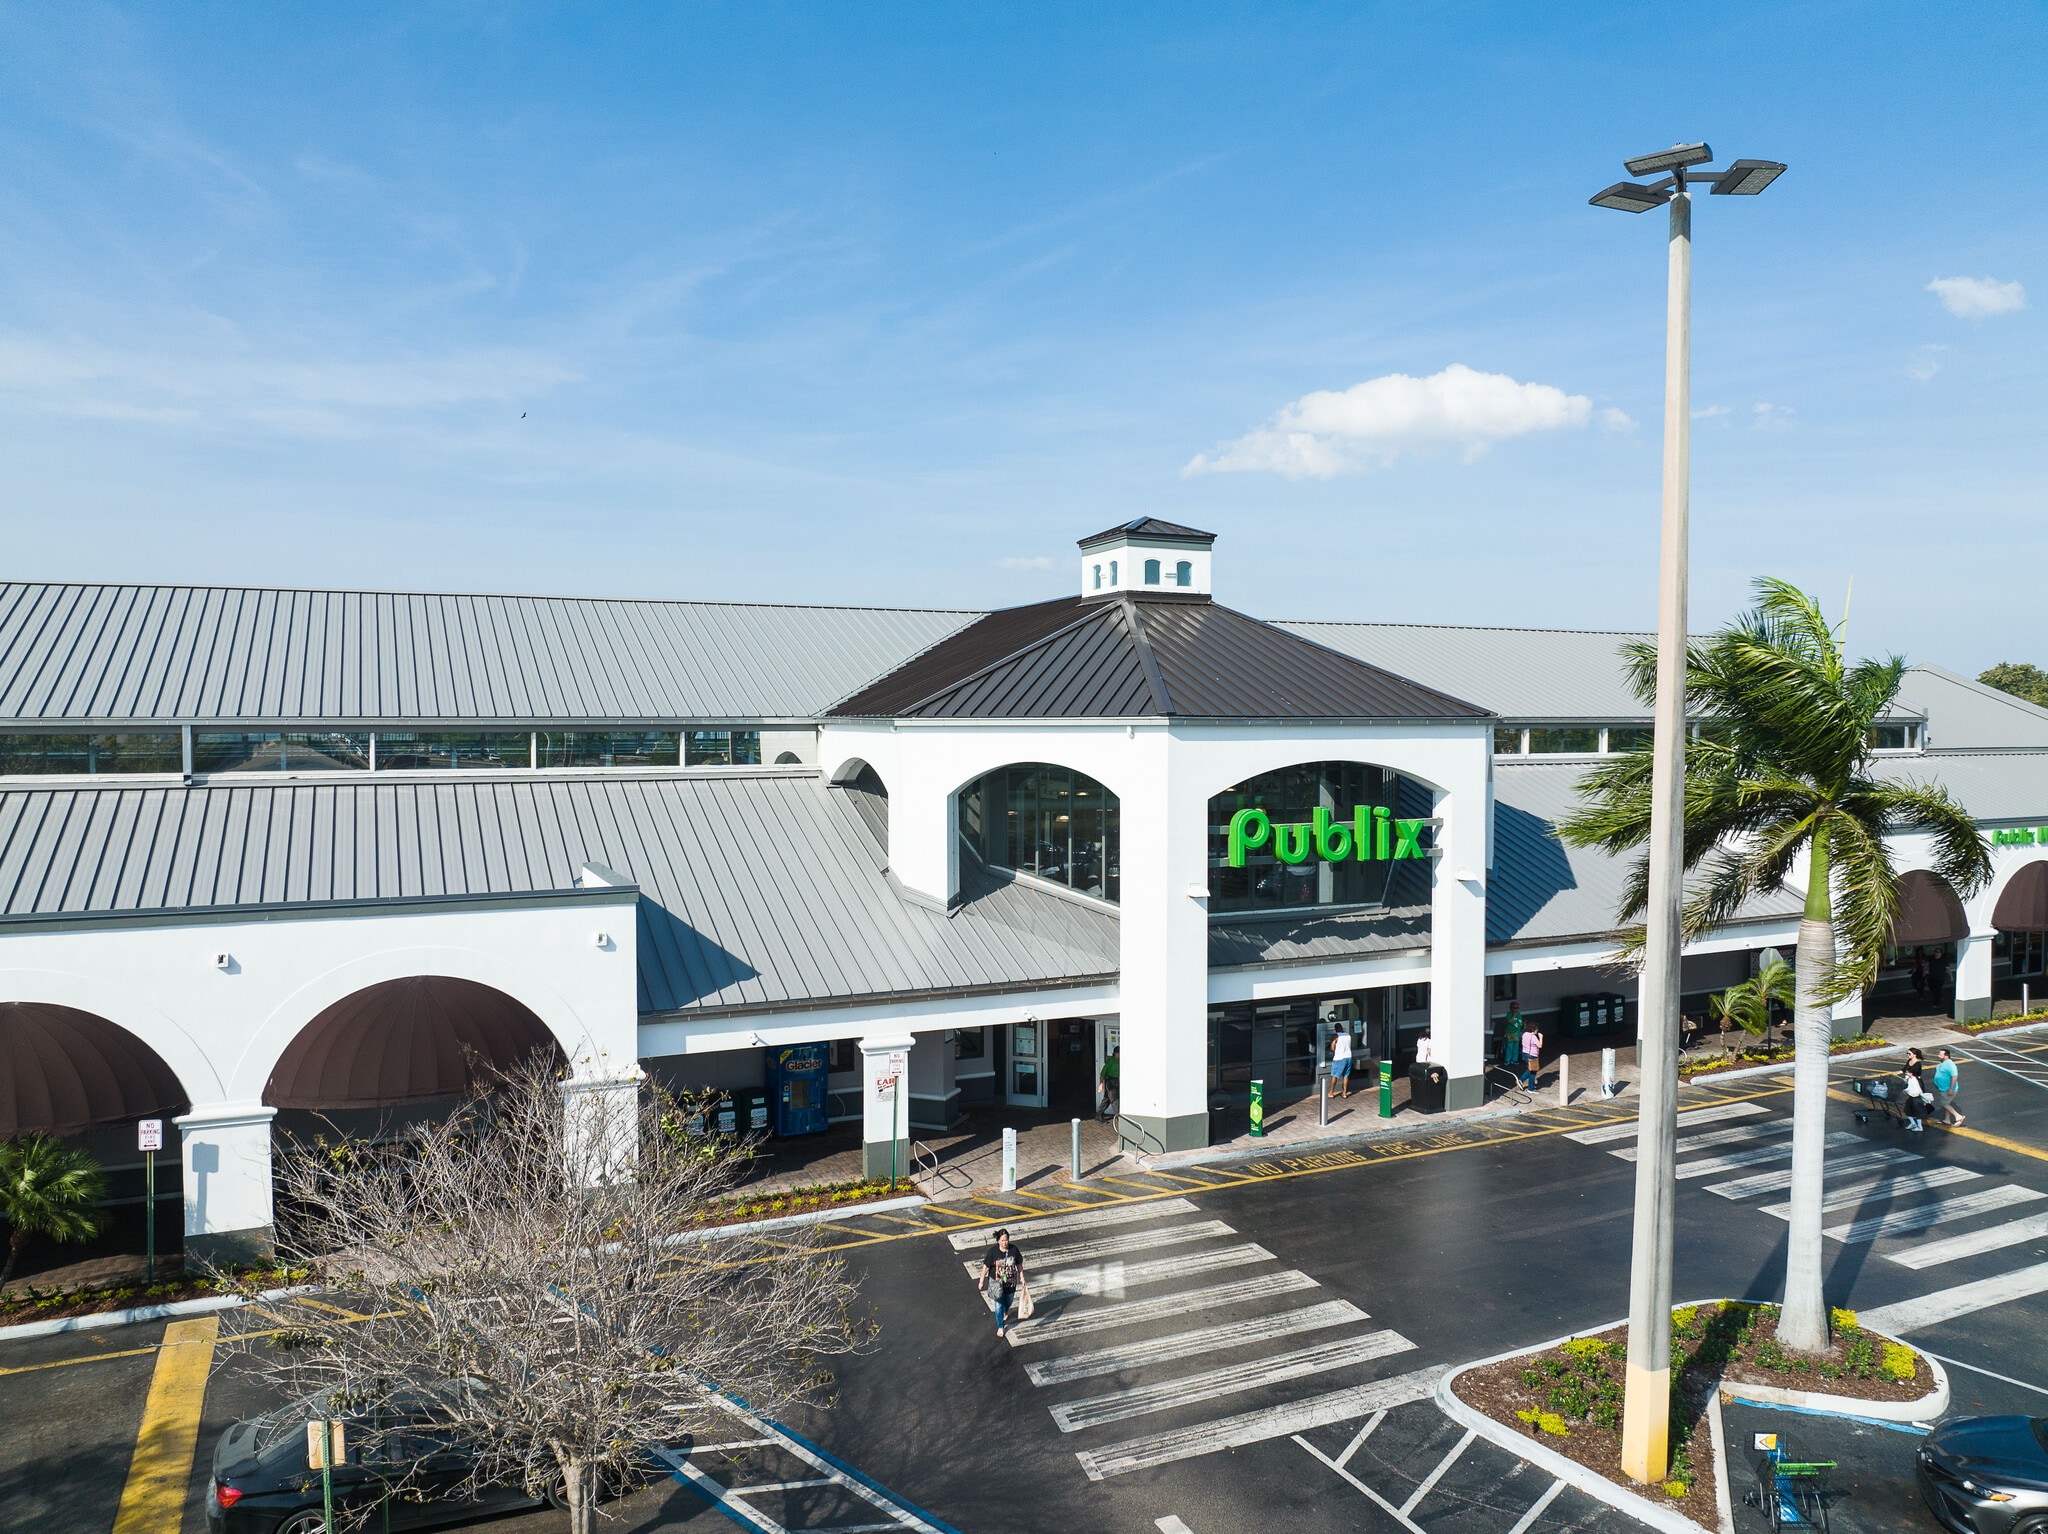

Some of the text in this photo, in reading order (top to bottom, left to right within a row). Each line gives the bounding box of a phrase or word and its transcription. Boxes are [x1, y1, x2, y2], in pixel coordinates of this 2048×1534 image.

[1229, 805, 1425, 868] Publix
[1992, 827, 2035, 846] Publix
[786, 1059, 822, 1071] Glacier
[1247, 1132, 1474, 1177] NO PARKING FIRE LANE
